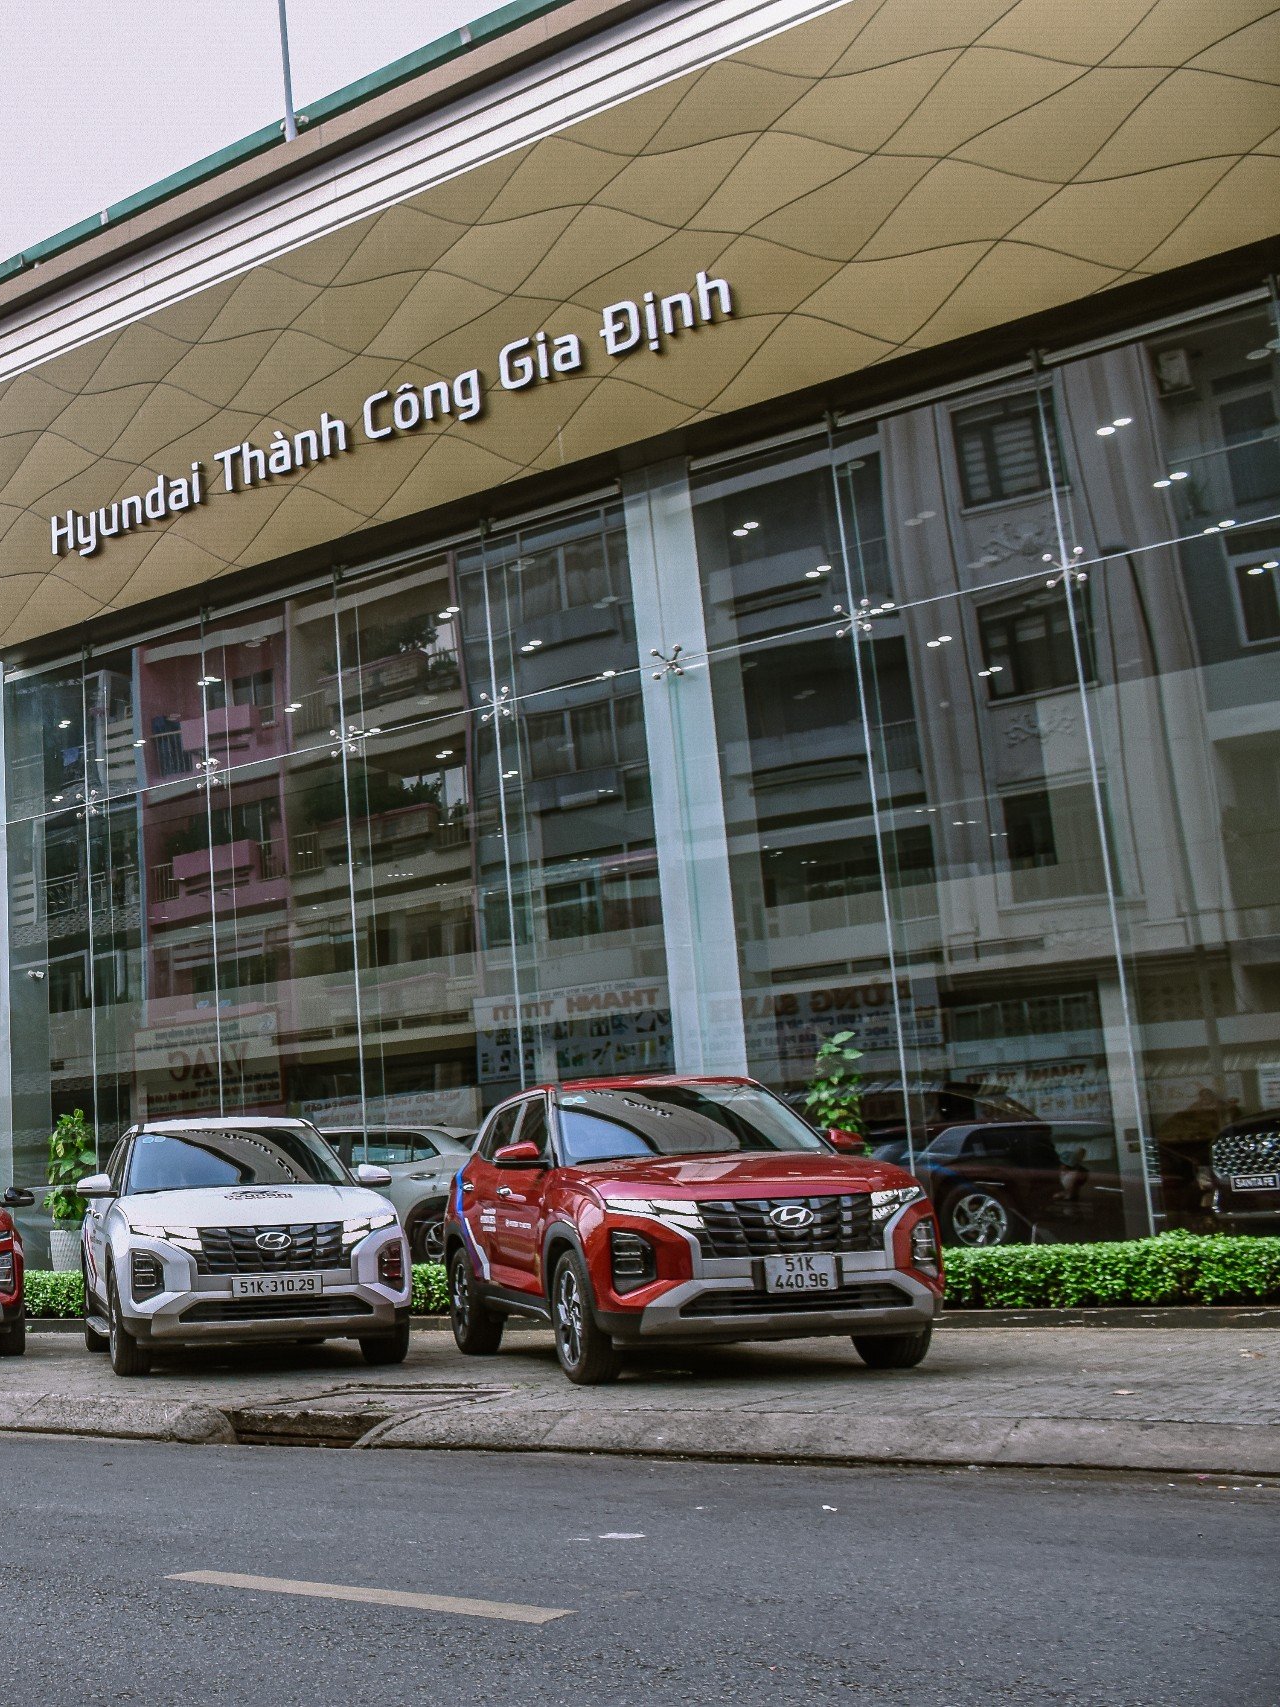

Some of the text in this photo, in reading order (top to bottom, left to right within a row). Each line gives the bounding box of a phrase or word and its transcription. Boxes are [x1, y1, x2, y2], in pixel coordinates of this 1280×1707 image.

[50, 271, 733, 557] Hyundai Thành Công Gia Định
[785, 1256, 815, 1272] 51K
[240, 1279, 315, 1293] 51K-310.29
[775, 1272, 829, 1289] 440.96
